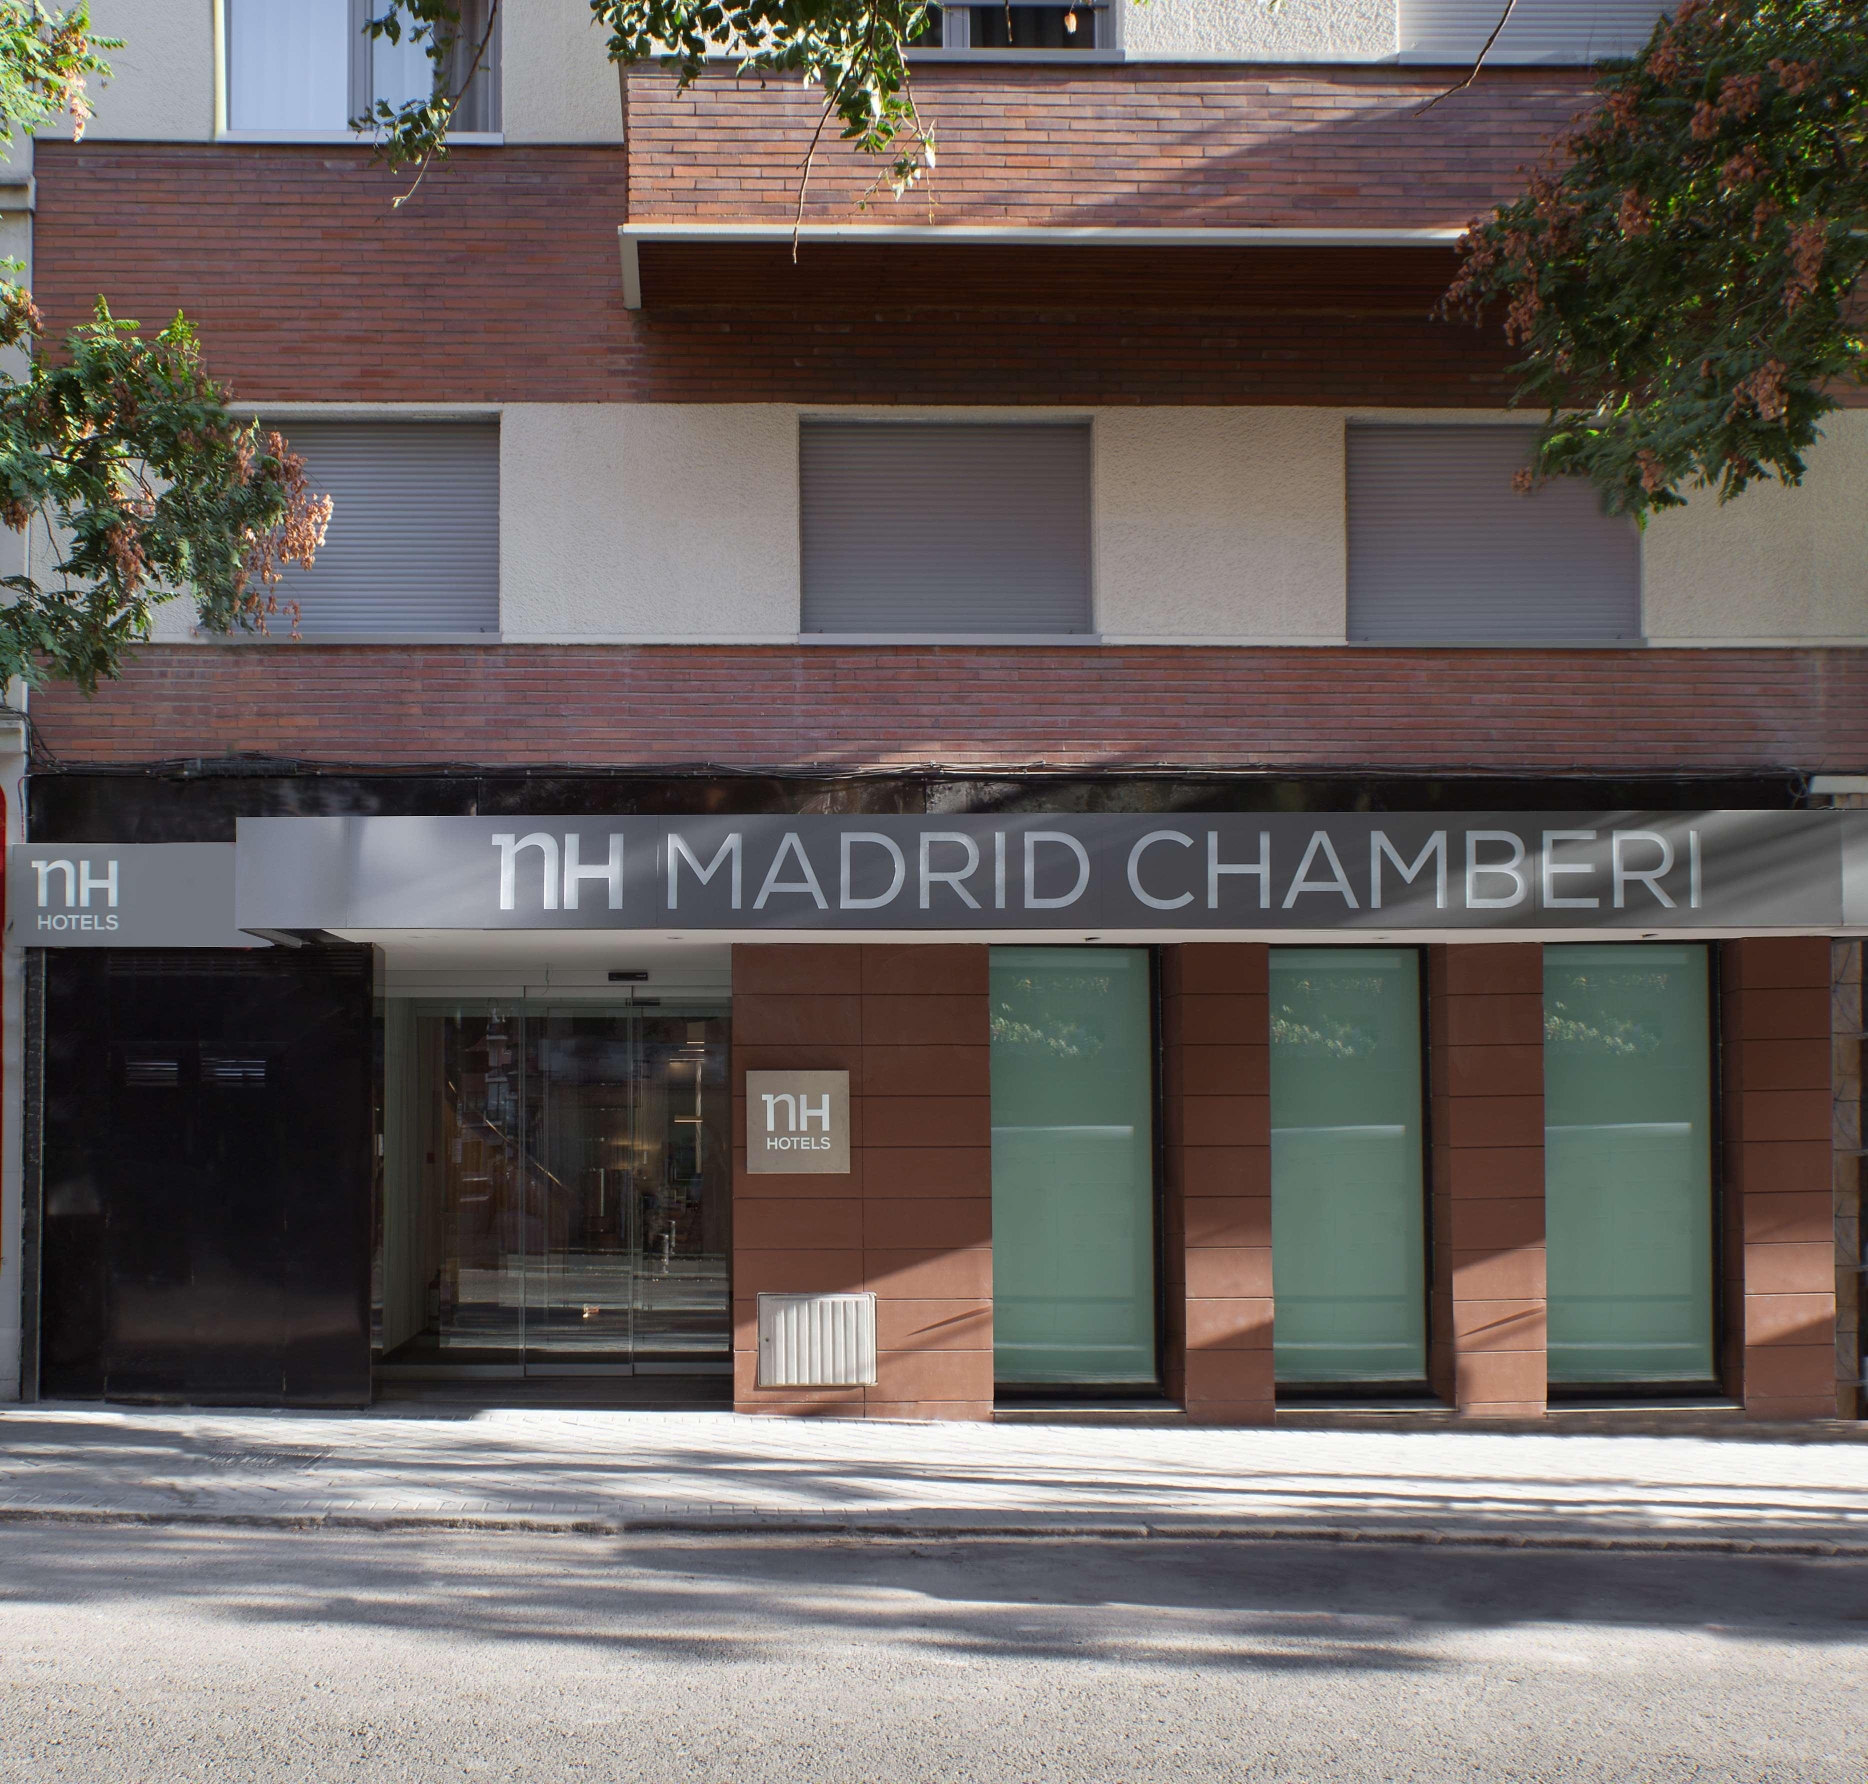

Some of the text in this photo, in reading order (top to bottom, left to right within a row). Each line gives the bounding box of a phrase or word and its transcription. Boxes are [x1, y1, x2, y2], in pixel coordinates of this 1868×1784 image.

[666, 830, 1091, 910] MADRID
[1126, 829, 1700, 910] CHAMBERI
[37, 914, 119, 931] HOTELS
[766, 1136, 831, 1150] HOTELS
